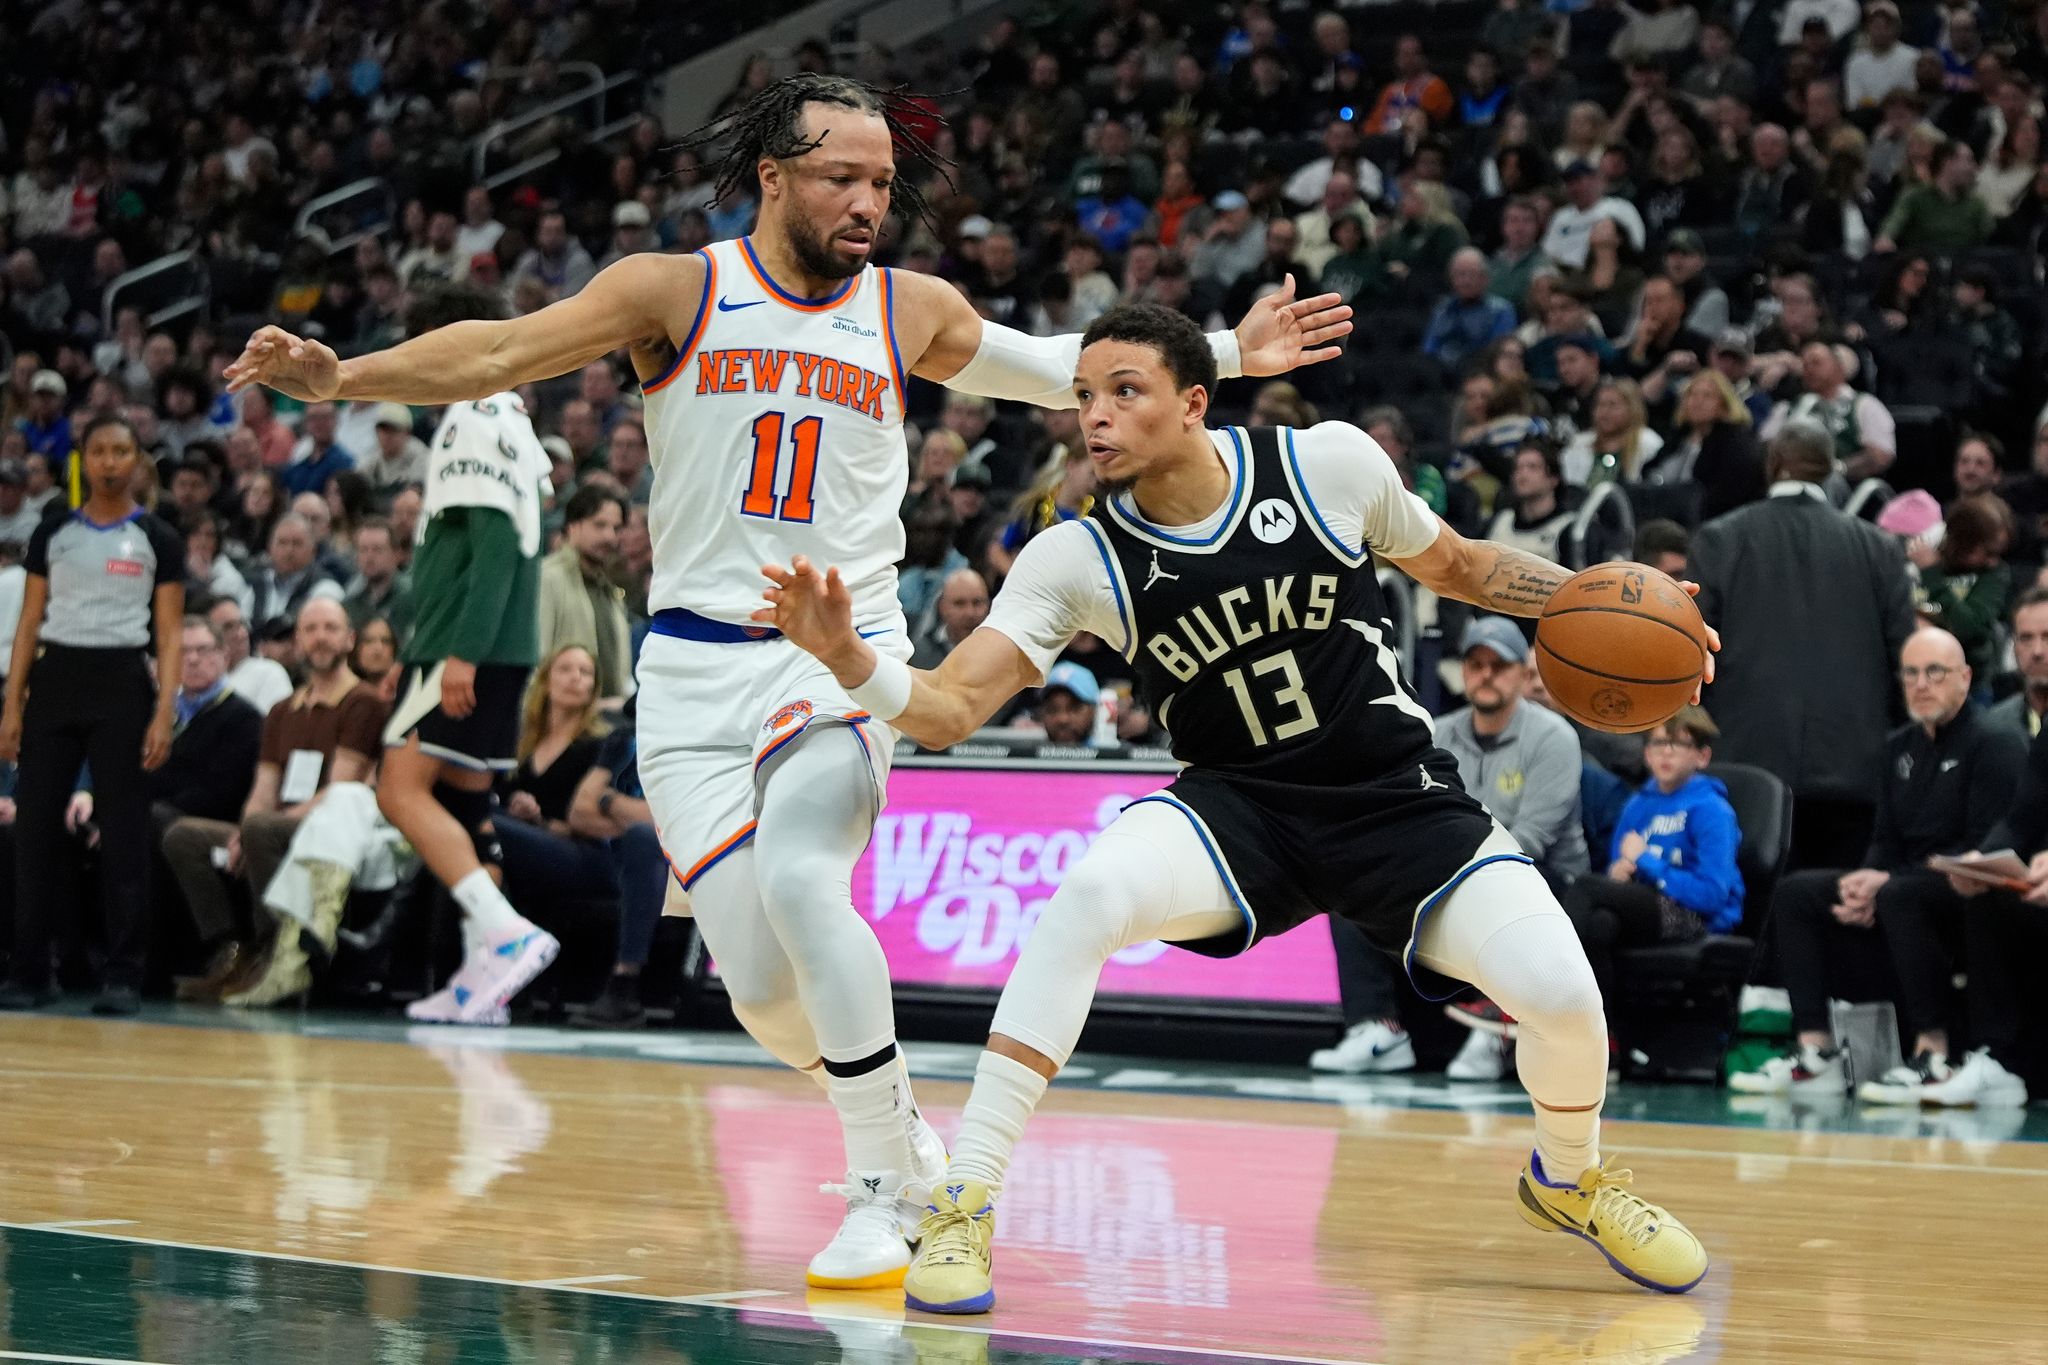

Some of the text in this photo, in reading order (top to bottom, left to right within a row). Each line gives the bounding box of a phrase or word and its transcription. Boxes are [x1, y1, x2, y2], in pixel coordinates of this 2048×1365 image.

[832, 321, 878, 338] abu dhabi
[696, 349, 889, 423] NEW YORK
[740, 410, 823, 524] 11
[1147, 574, 1339, 683] BUCKS
[1223, 649, 1320, 747] 13
[872, 811, 1099, 921] Wisco
